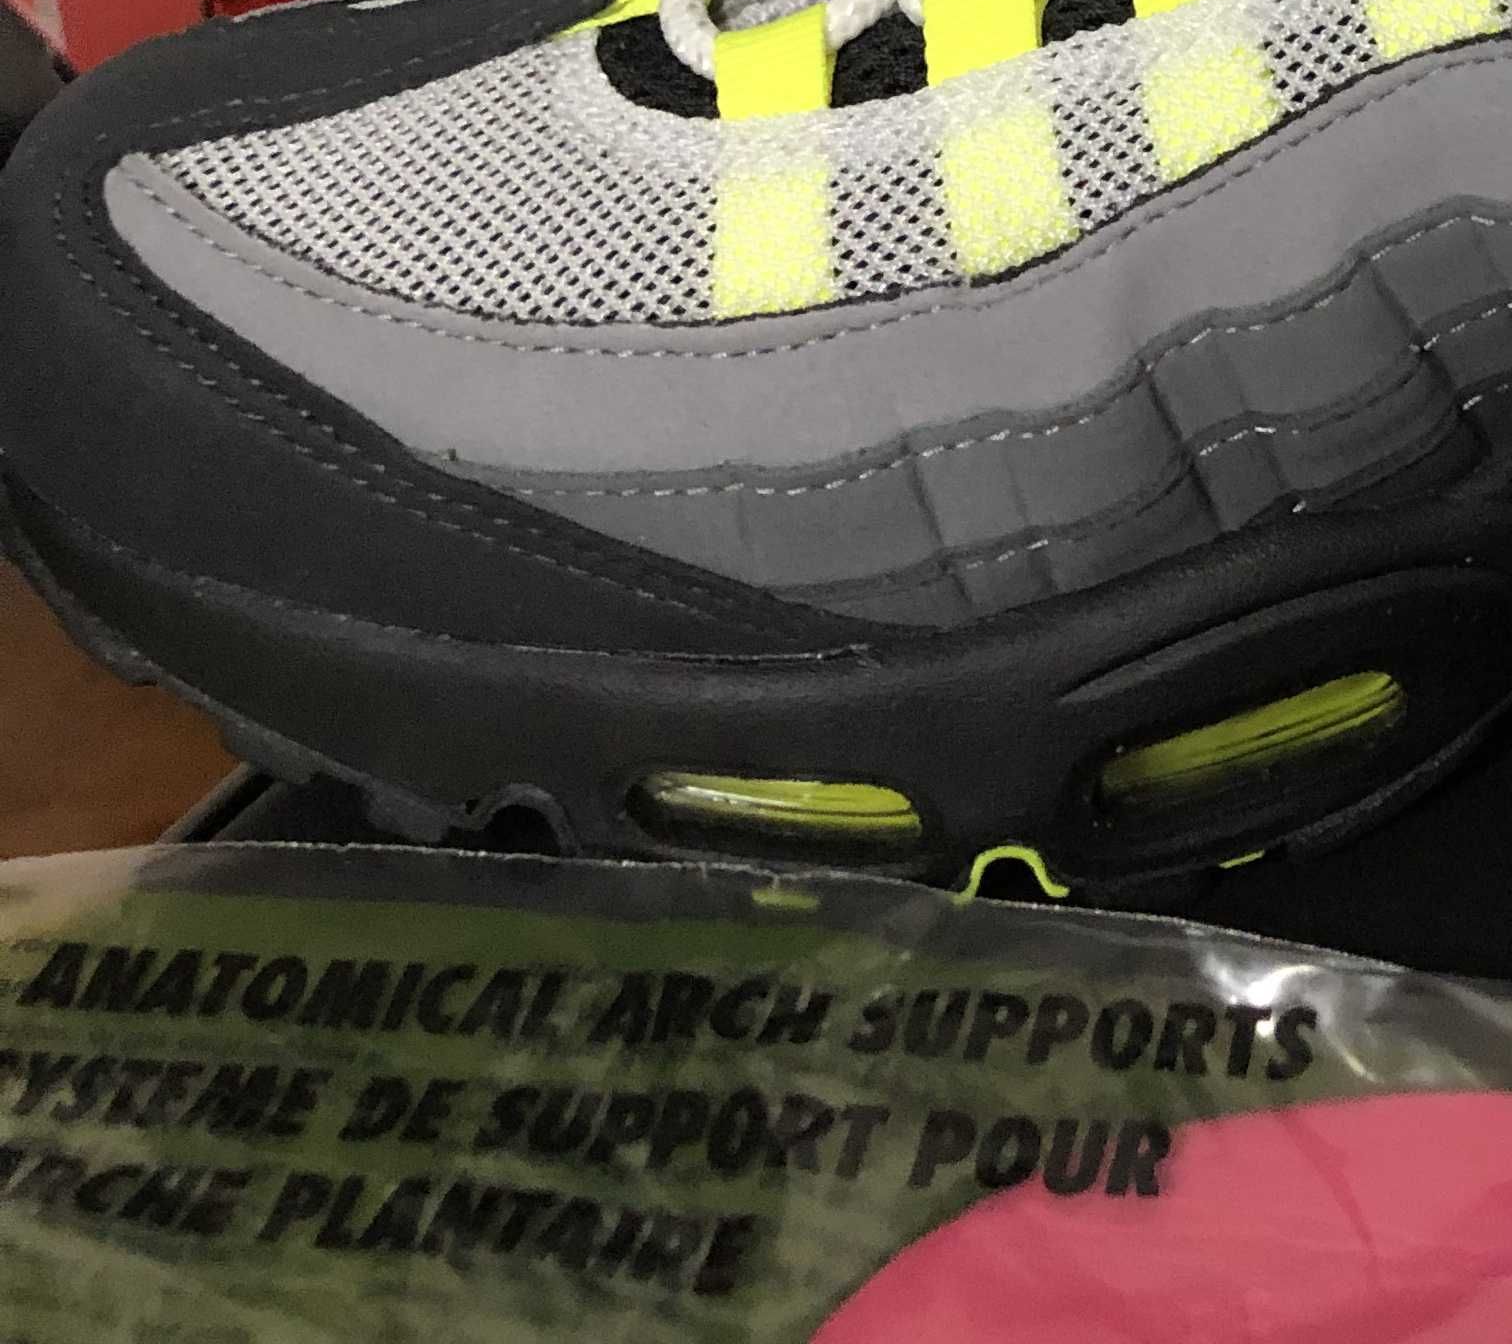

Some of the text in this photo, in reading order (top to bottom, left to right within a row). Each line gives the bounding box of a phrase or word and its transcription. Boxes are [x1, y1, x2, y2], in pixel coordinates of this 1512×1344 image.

[16, 942, 1318, 1082] ANATOMICAL ARCH SUPPORTS
[338, 1075, 467, 1142] DE
[473, 1085, 891, 1180] SUPPORT
[907, 1108, 1172, 1197] POUR
[255, 1171, 760, 1296] PLANTAIRE
